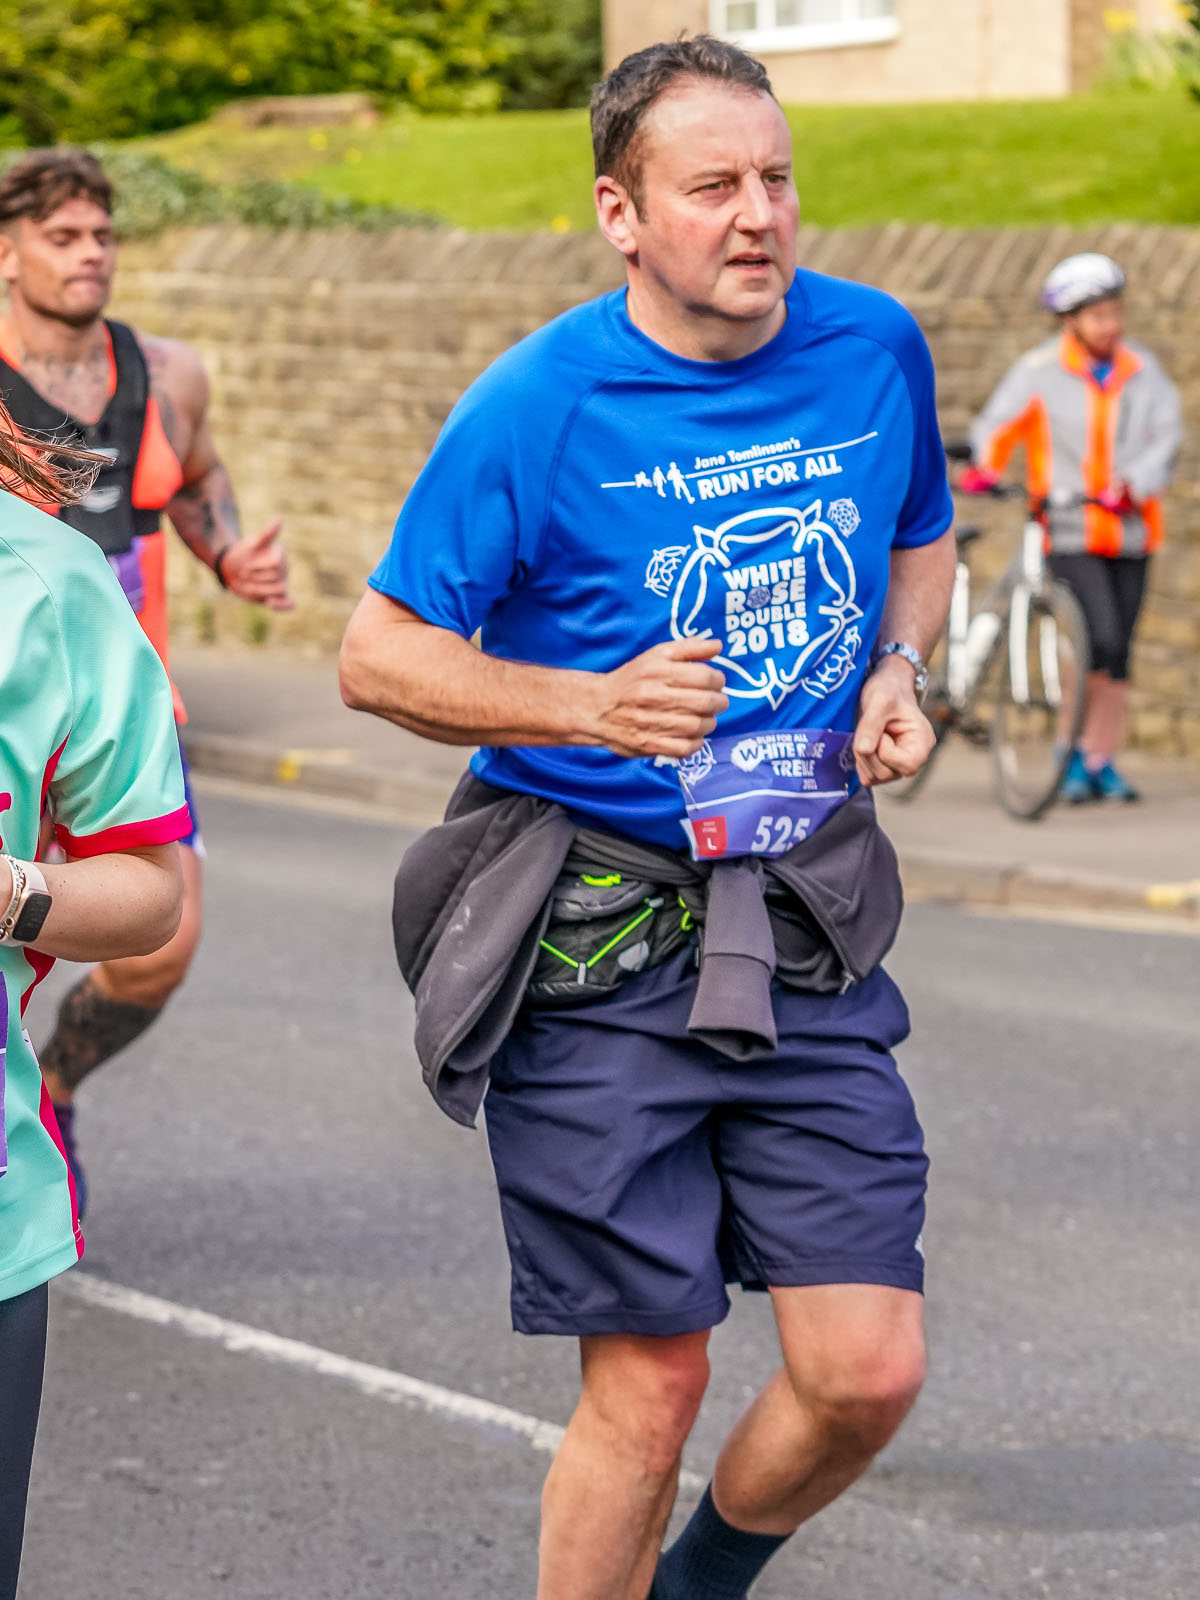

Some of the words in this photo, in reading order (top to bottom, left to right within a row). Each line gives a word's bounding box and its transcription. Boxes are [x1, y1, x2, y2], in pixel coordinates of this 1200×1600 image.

[694, 455, 726, 470] Jane
[727, 437, 801, 463] Tomlinson's
[697, 470, 750, 500] RUN
[751, 461, 800, 488] FOR
[805, 453, 843, 479] ALL
[722, 556, 806, 591] WHITE
[725, 600, 807, 632] DOUBLE
[727, 619, 810, 657] 2018
[739, 742, 796, 762] WHITE
[793, 733, 809, 743] ALL
